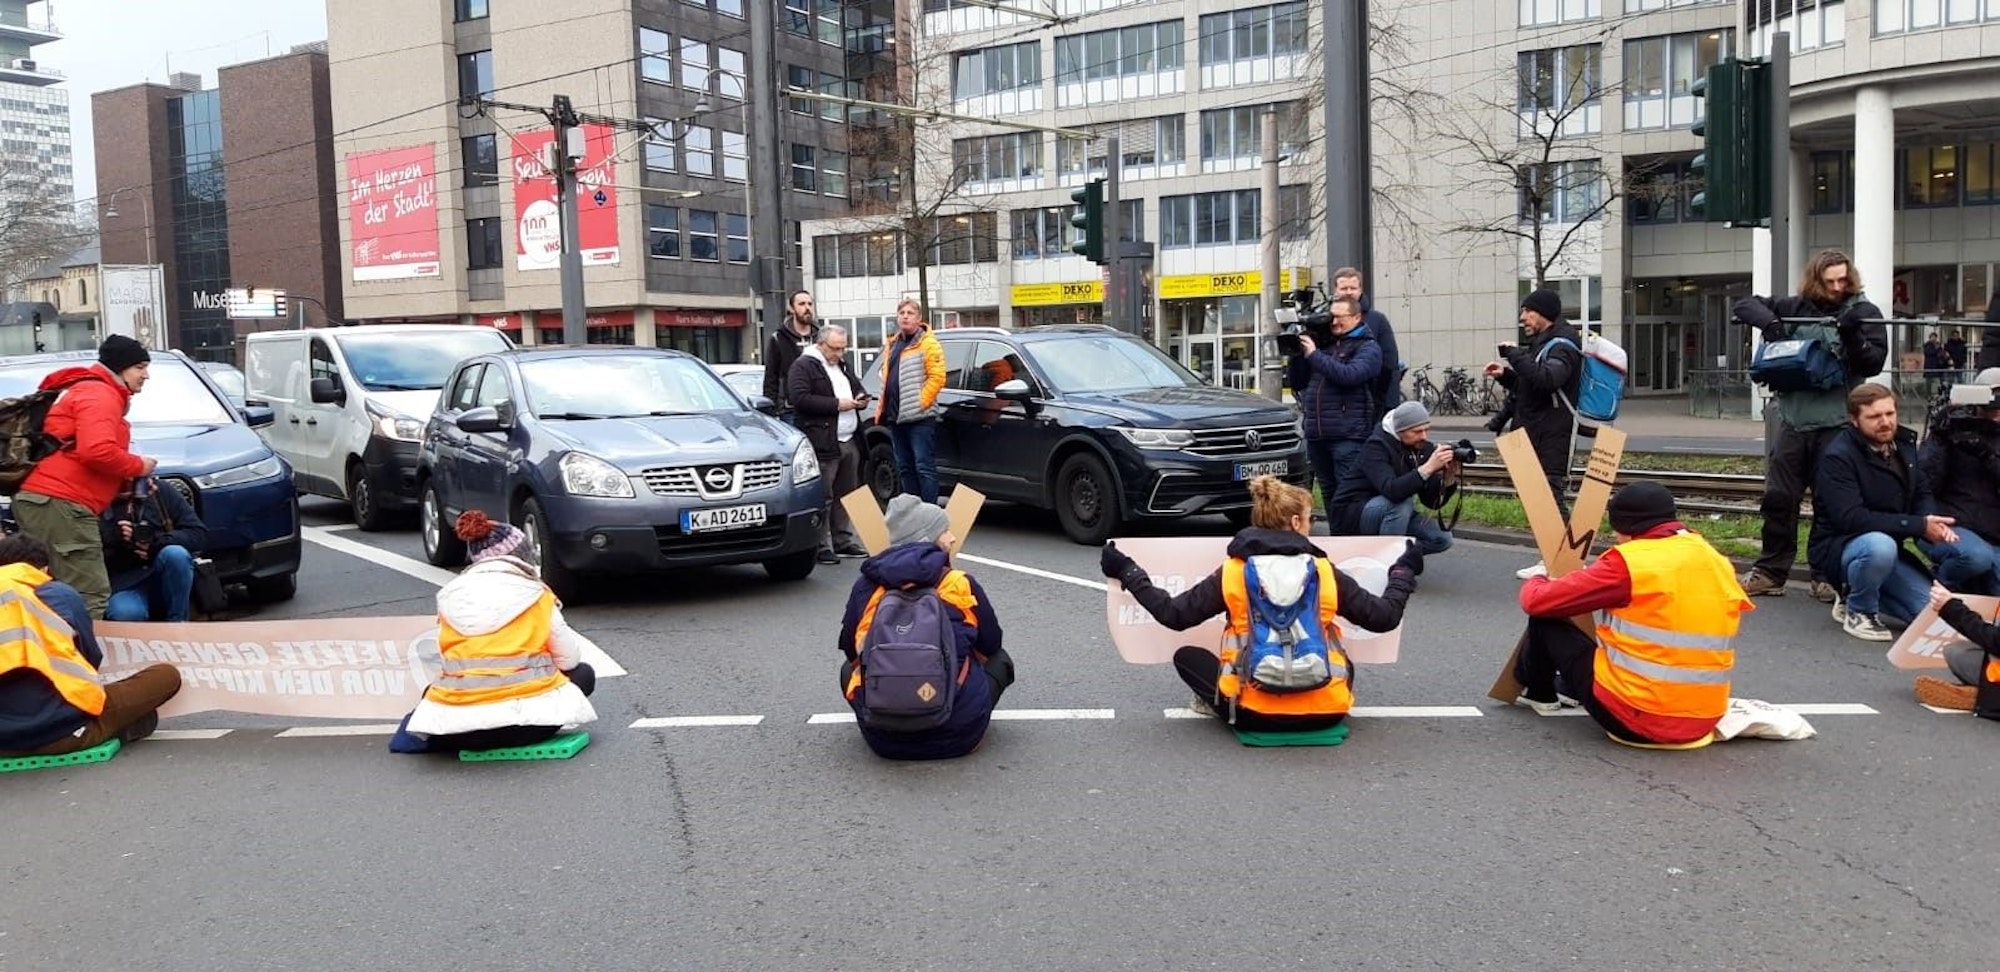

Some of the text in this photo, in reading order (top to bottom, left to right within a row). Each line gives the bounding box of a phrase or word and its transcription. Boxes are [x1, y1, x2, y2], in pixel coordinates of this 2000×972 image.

[351, 163, 422, 201] Im Herzen
[364, 179, 434, 225] der Stadt!
[543, 240, 561, 253] VHS
[1063, 284, 1092, 295] DEKO
[1213, 275, 1245, 287] DEKO
[193, 290, 227, 309] Muse
[691, 506, 764, 527] K AD 2611
